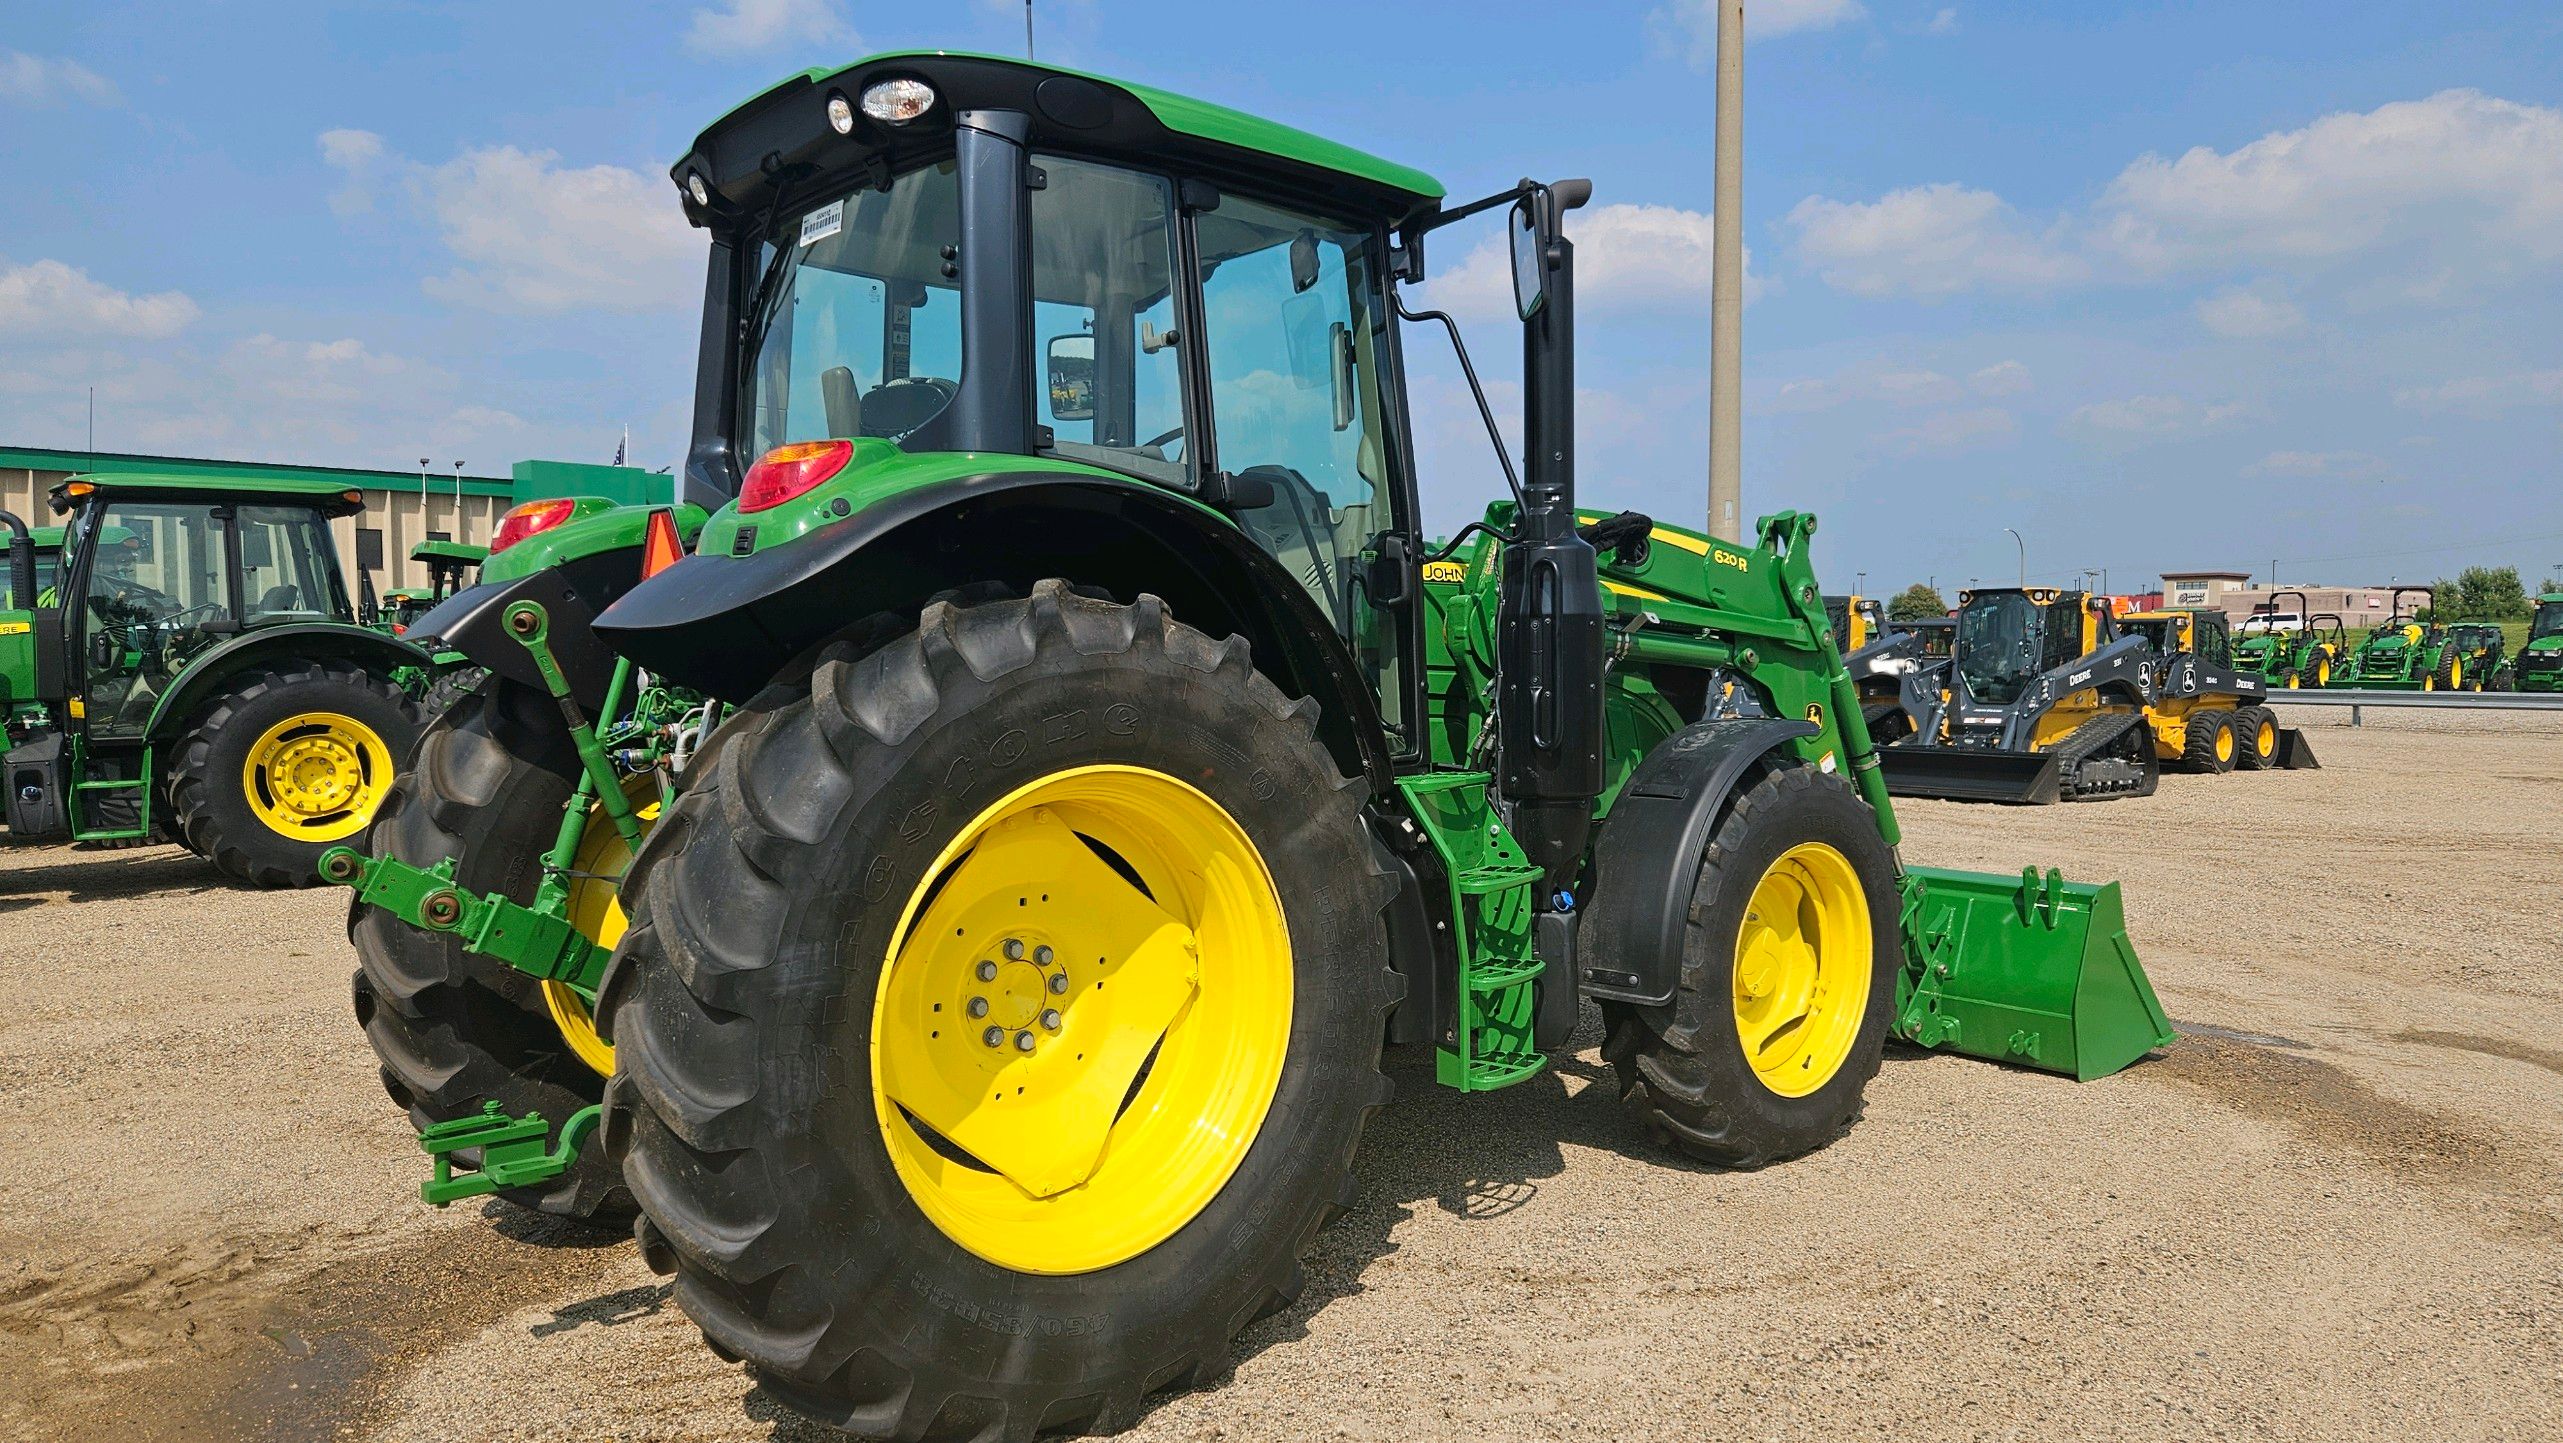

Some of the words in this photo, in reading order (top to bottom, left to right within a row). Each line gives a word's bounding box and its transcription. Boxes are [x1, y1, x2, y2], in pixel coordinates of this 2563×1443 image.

[1424, 564, 1465, 579] JOHN
[2069, 669, 2092, 686] DEERE
[2235, 678, 2256, 690] DEERE
